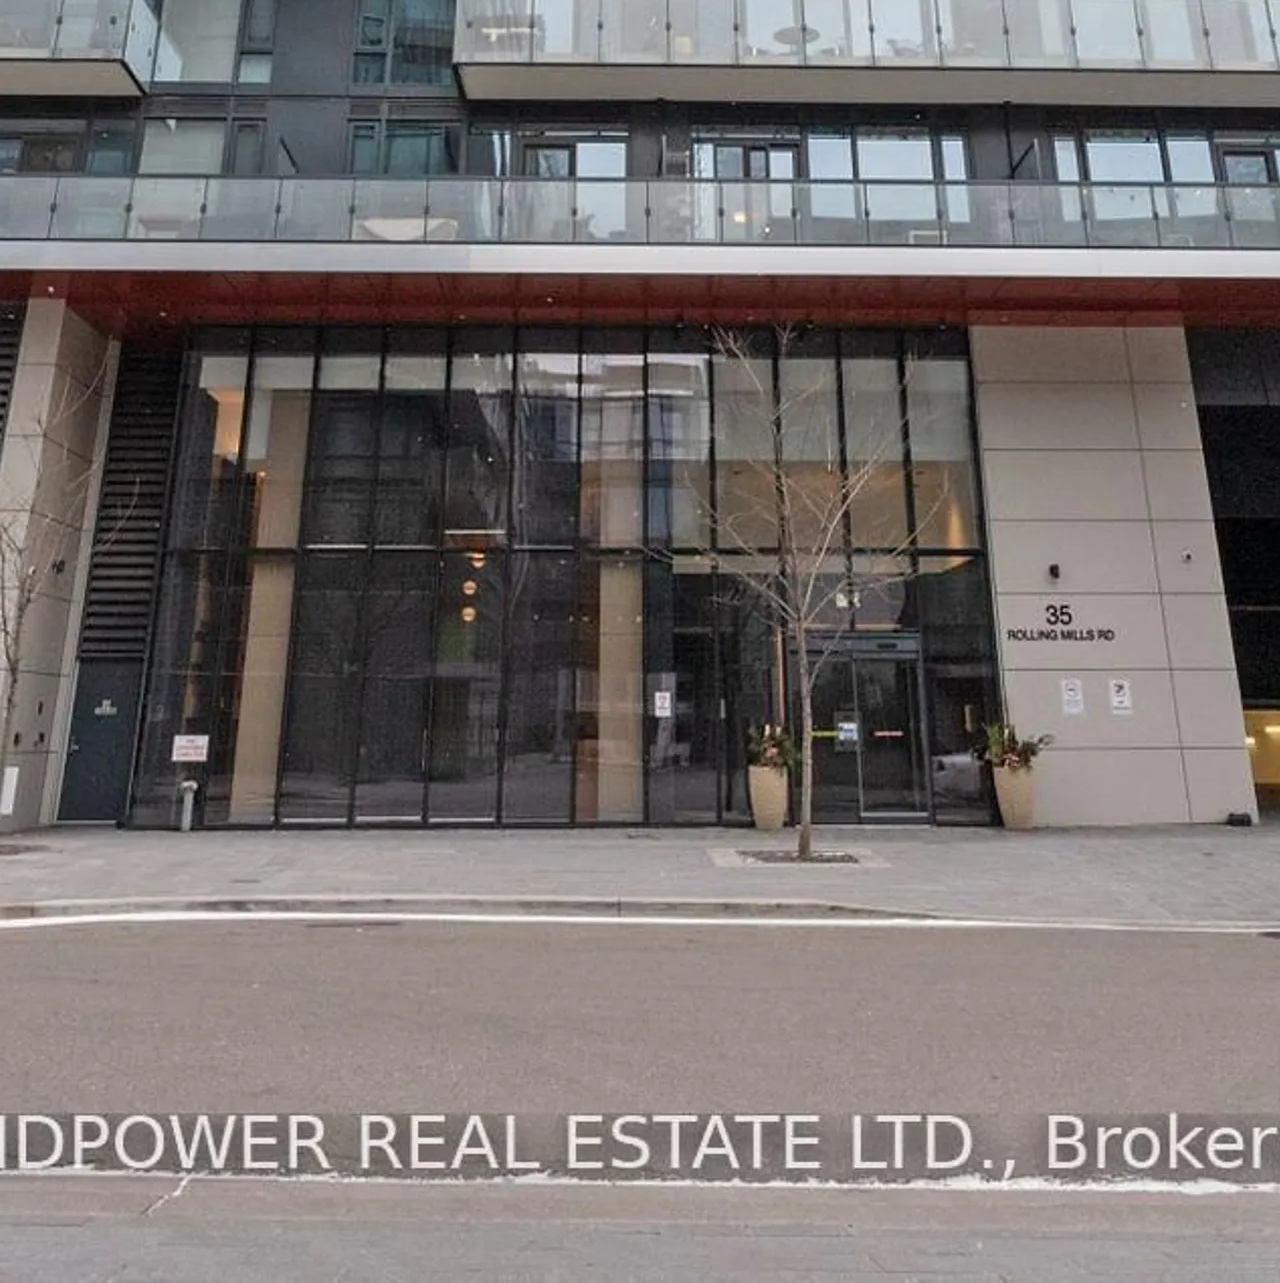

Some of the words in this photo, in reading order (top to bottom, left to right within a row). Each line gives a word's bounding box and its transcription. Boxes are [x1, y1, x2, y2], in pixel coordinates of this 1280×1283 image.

[1046, 604, 1072, 625] 35
[1007, 629, 1058, 641] ROLLING
[1060, 629, 1095, 641] MILLS
[1096, 629, 1115, 641] RD
